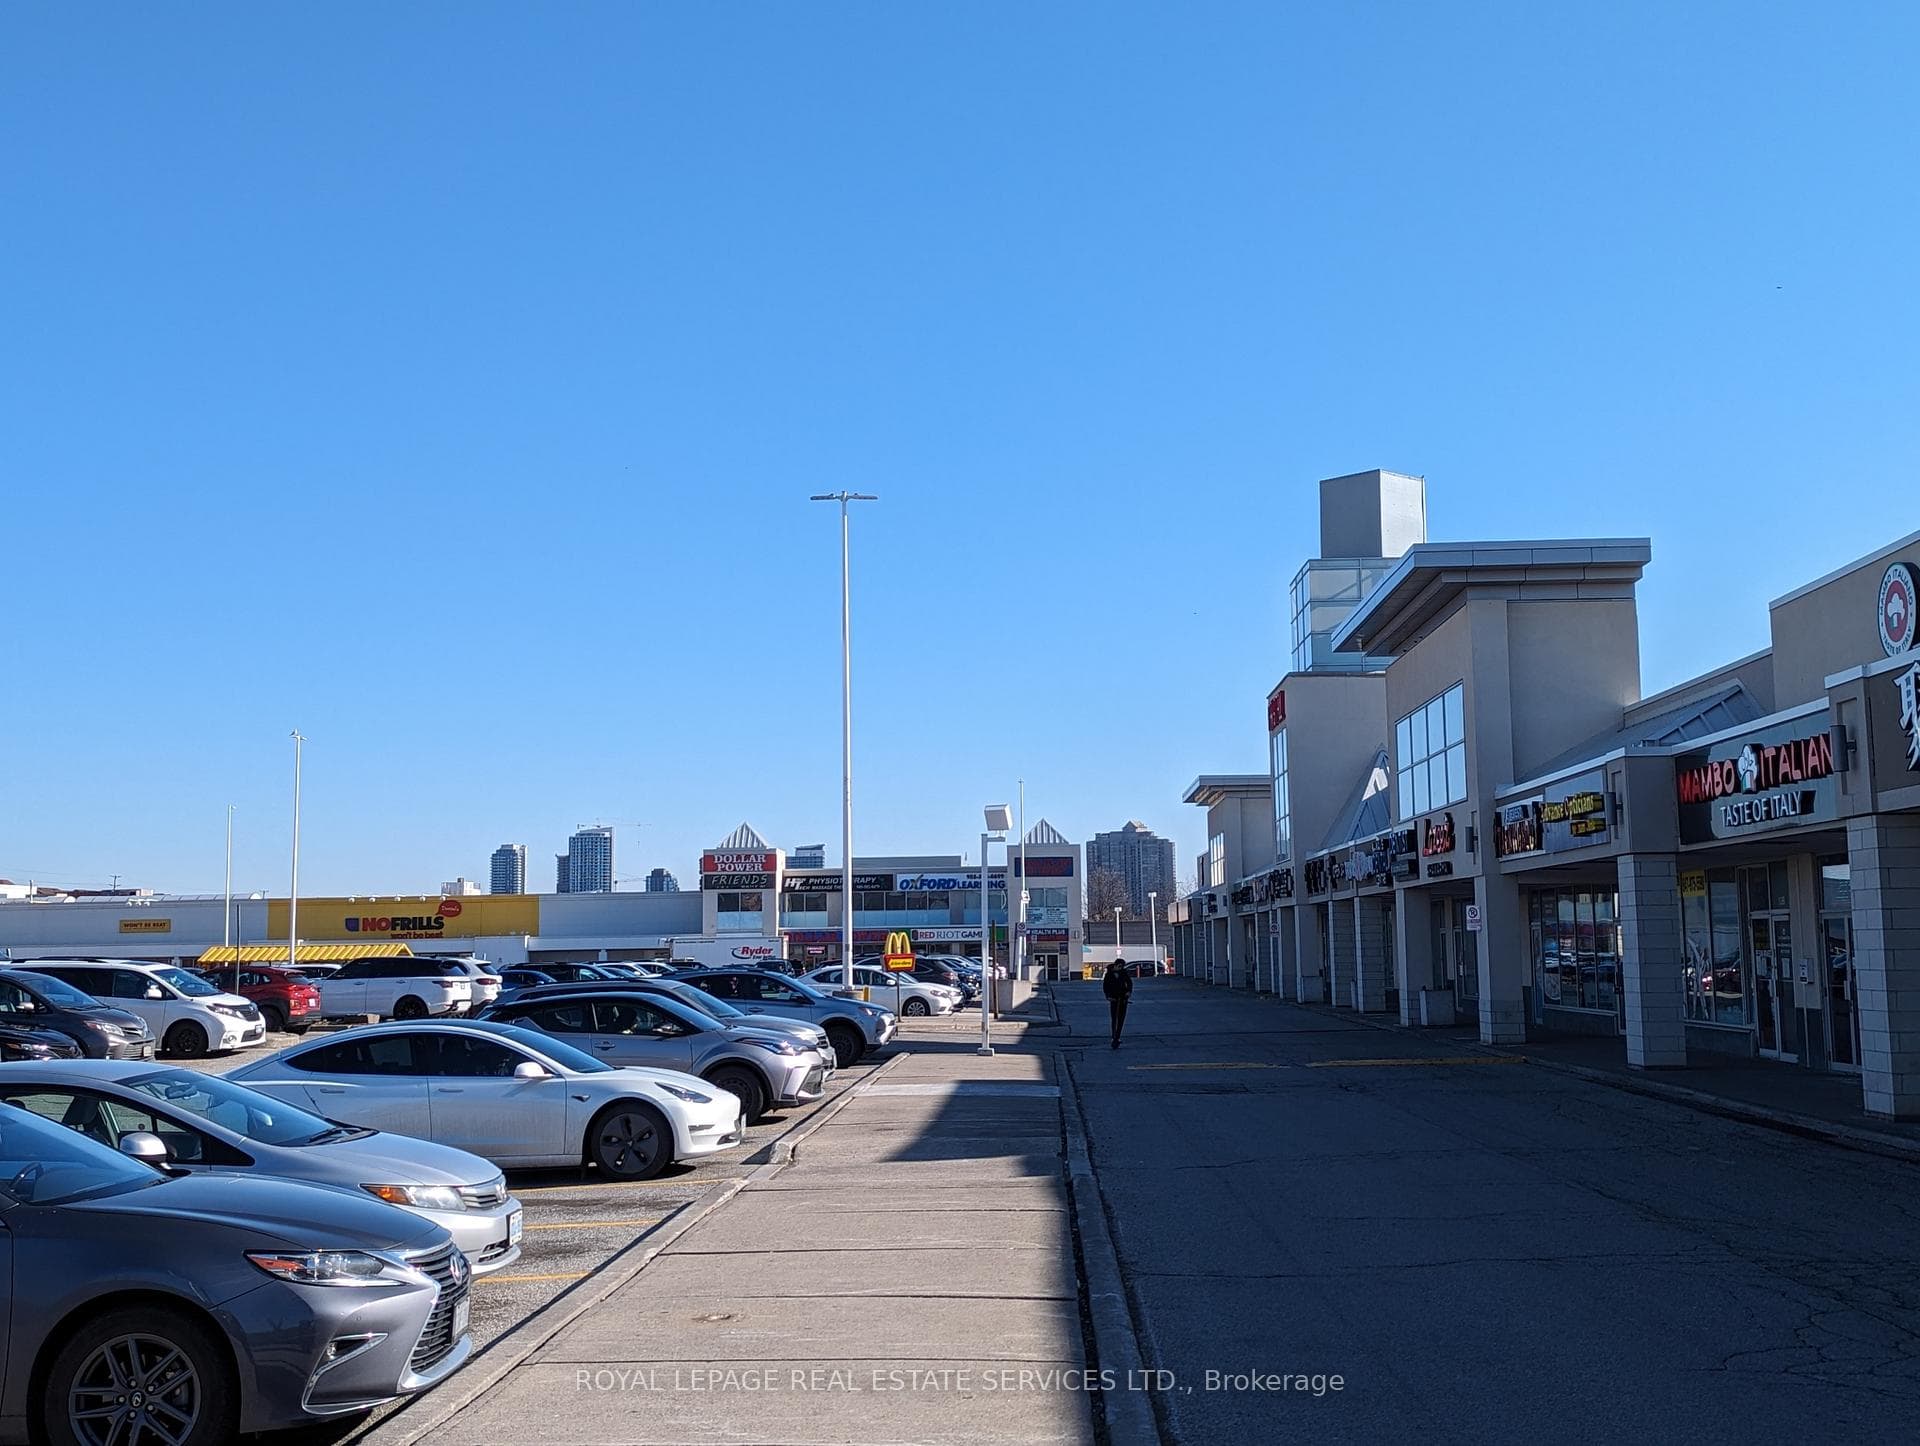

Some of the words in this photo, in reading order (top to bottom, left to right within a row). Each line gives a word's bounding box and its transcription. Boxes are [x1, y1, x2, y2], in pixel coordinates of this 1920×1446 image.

[1679, 759, 1735, 803] MAMBO
[1719, 802, 1751, 827] TASTE
[1752, 797, 1768, 822] OF
[1769, 790, 1801, 819] ITALY
[714, 854, 766, 863] DOLLAR
[717, 863, 763, 872] POWER
[712, 874, 768, 885] FRIENDS
[899, 873, 958, 890] OXFORD
[919, 931, 935, 939] RED
[936, 931, 960, 939] RIOT
[741, 946, 773, 957] Ryder
